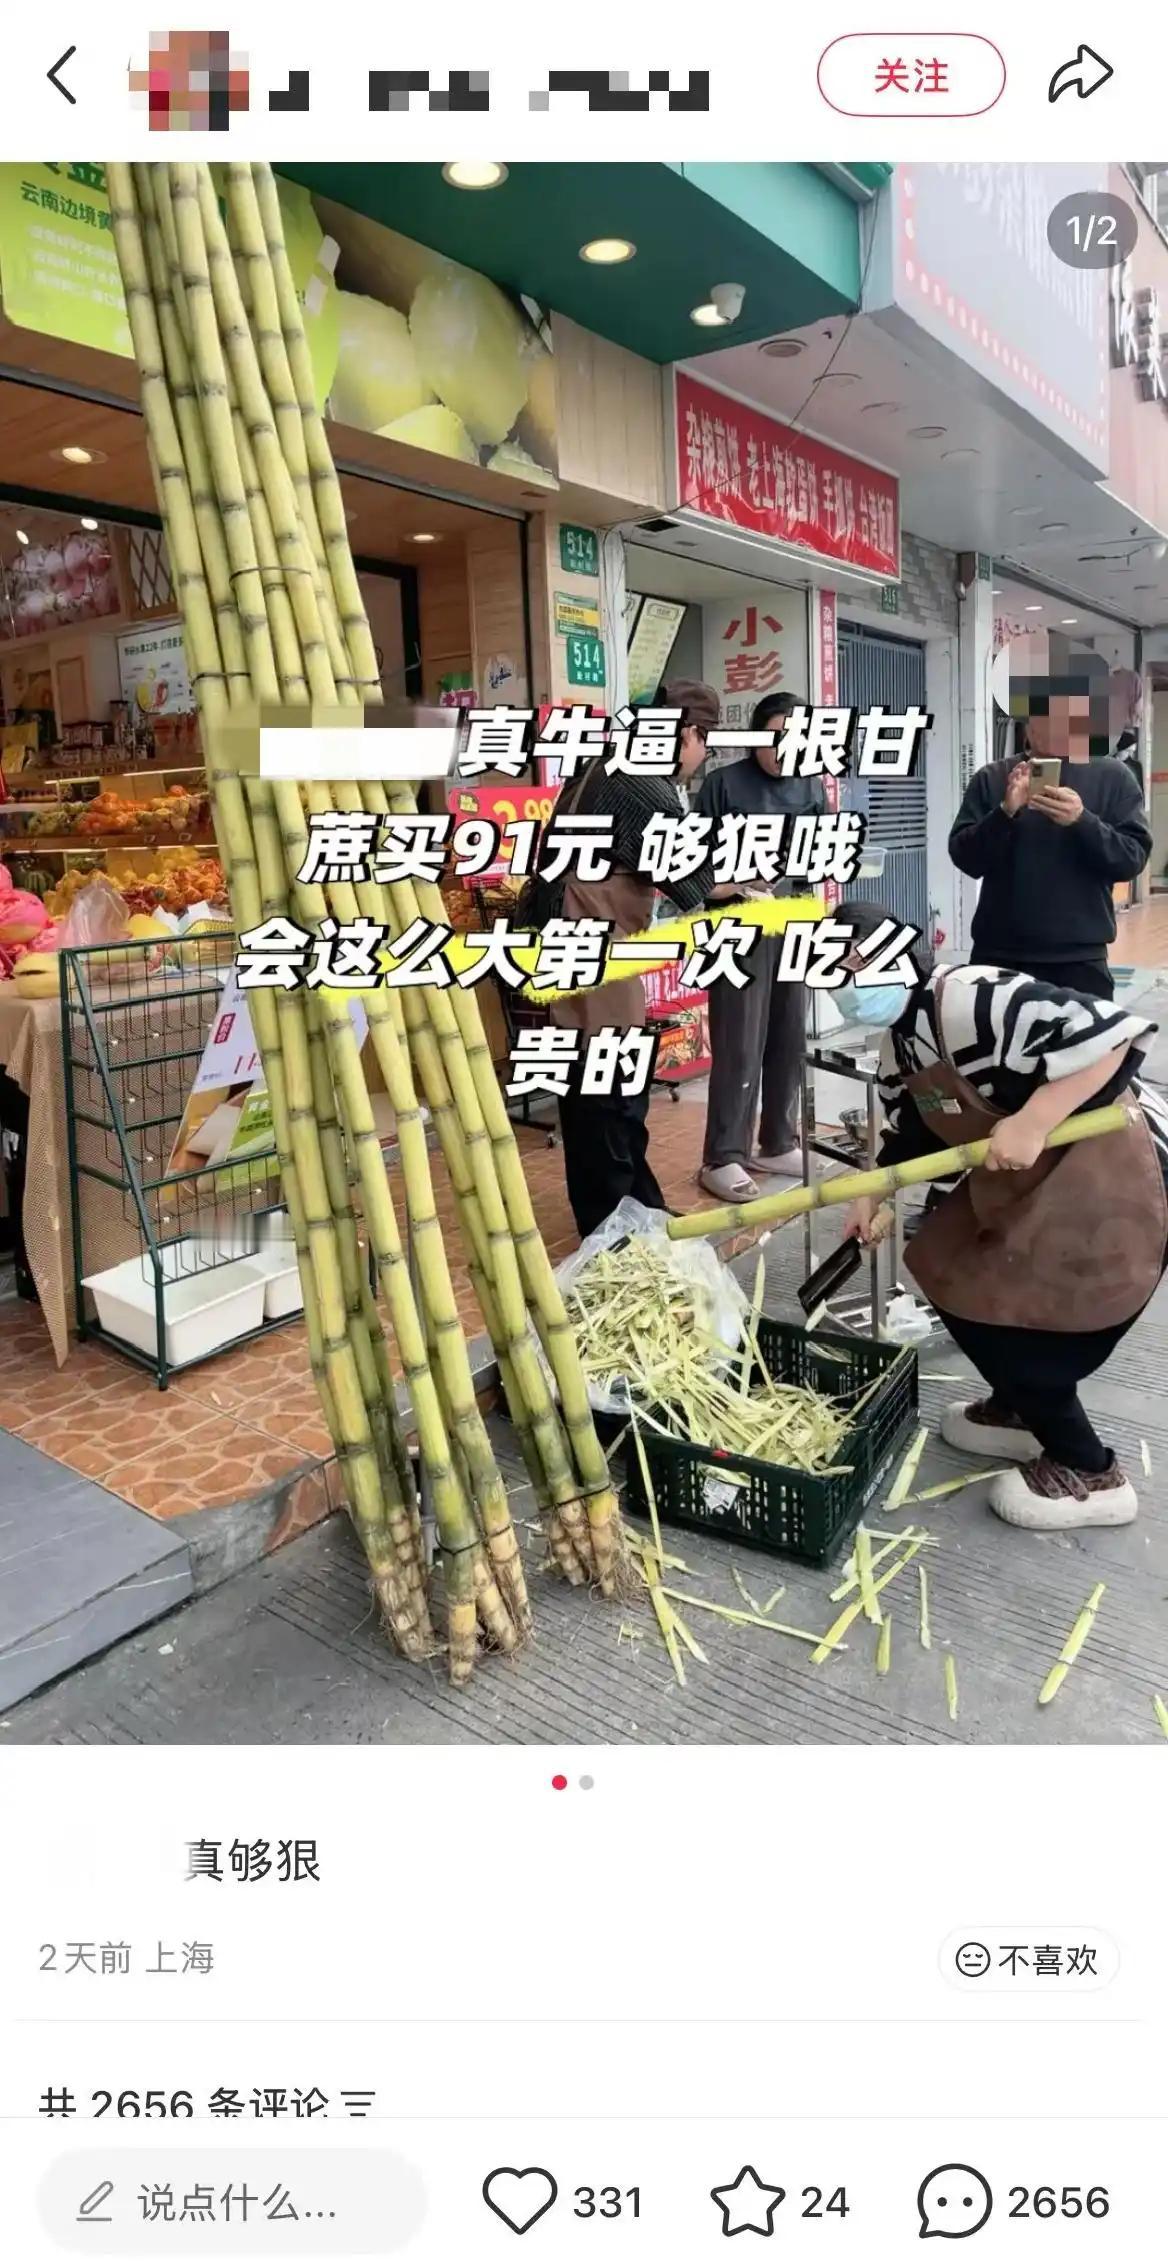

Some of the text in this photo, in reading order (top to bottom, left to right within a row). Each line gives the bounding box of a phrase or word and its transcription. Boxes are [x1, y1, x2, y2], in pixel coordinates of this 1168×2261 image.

[566, 531, 594, 561] 514
[573, 641, 601, 669] 514
[722, 606, 785, 695] 小彭
